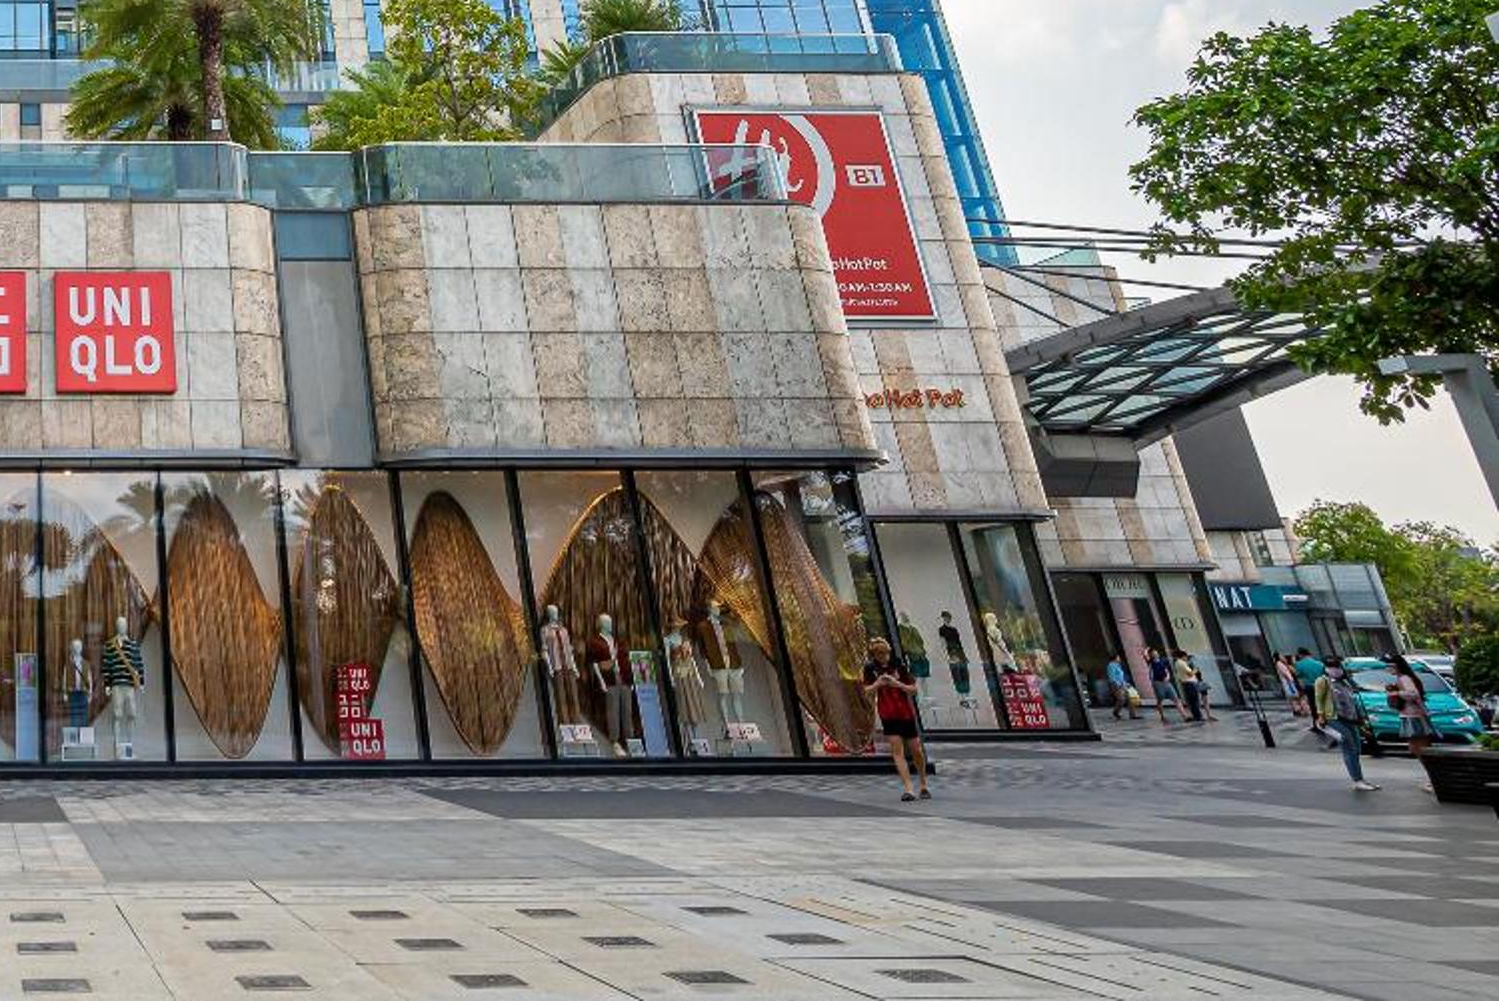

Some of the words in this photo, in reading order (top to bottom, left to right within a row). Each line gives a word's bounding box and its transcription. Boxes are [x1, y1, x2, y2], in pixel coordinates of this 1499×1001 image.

[853, 168, 879, 184] B1
[68, 286, 151, 327] UNI
[69, 334, 162, 382] QLO
[350, 722, 377, 737] UNI
[352, 738, 381, 755] QLO
